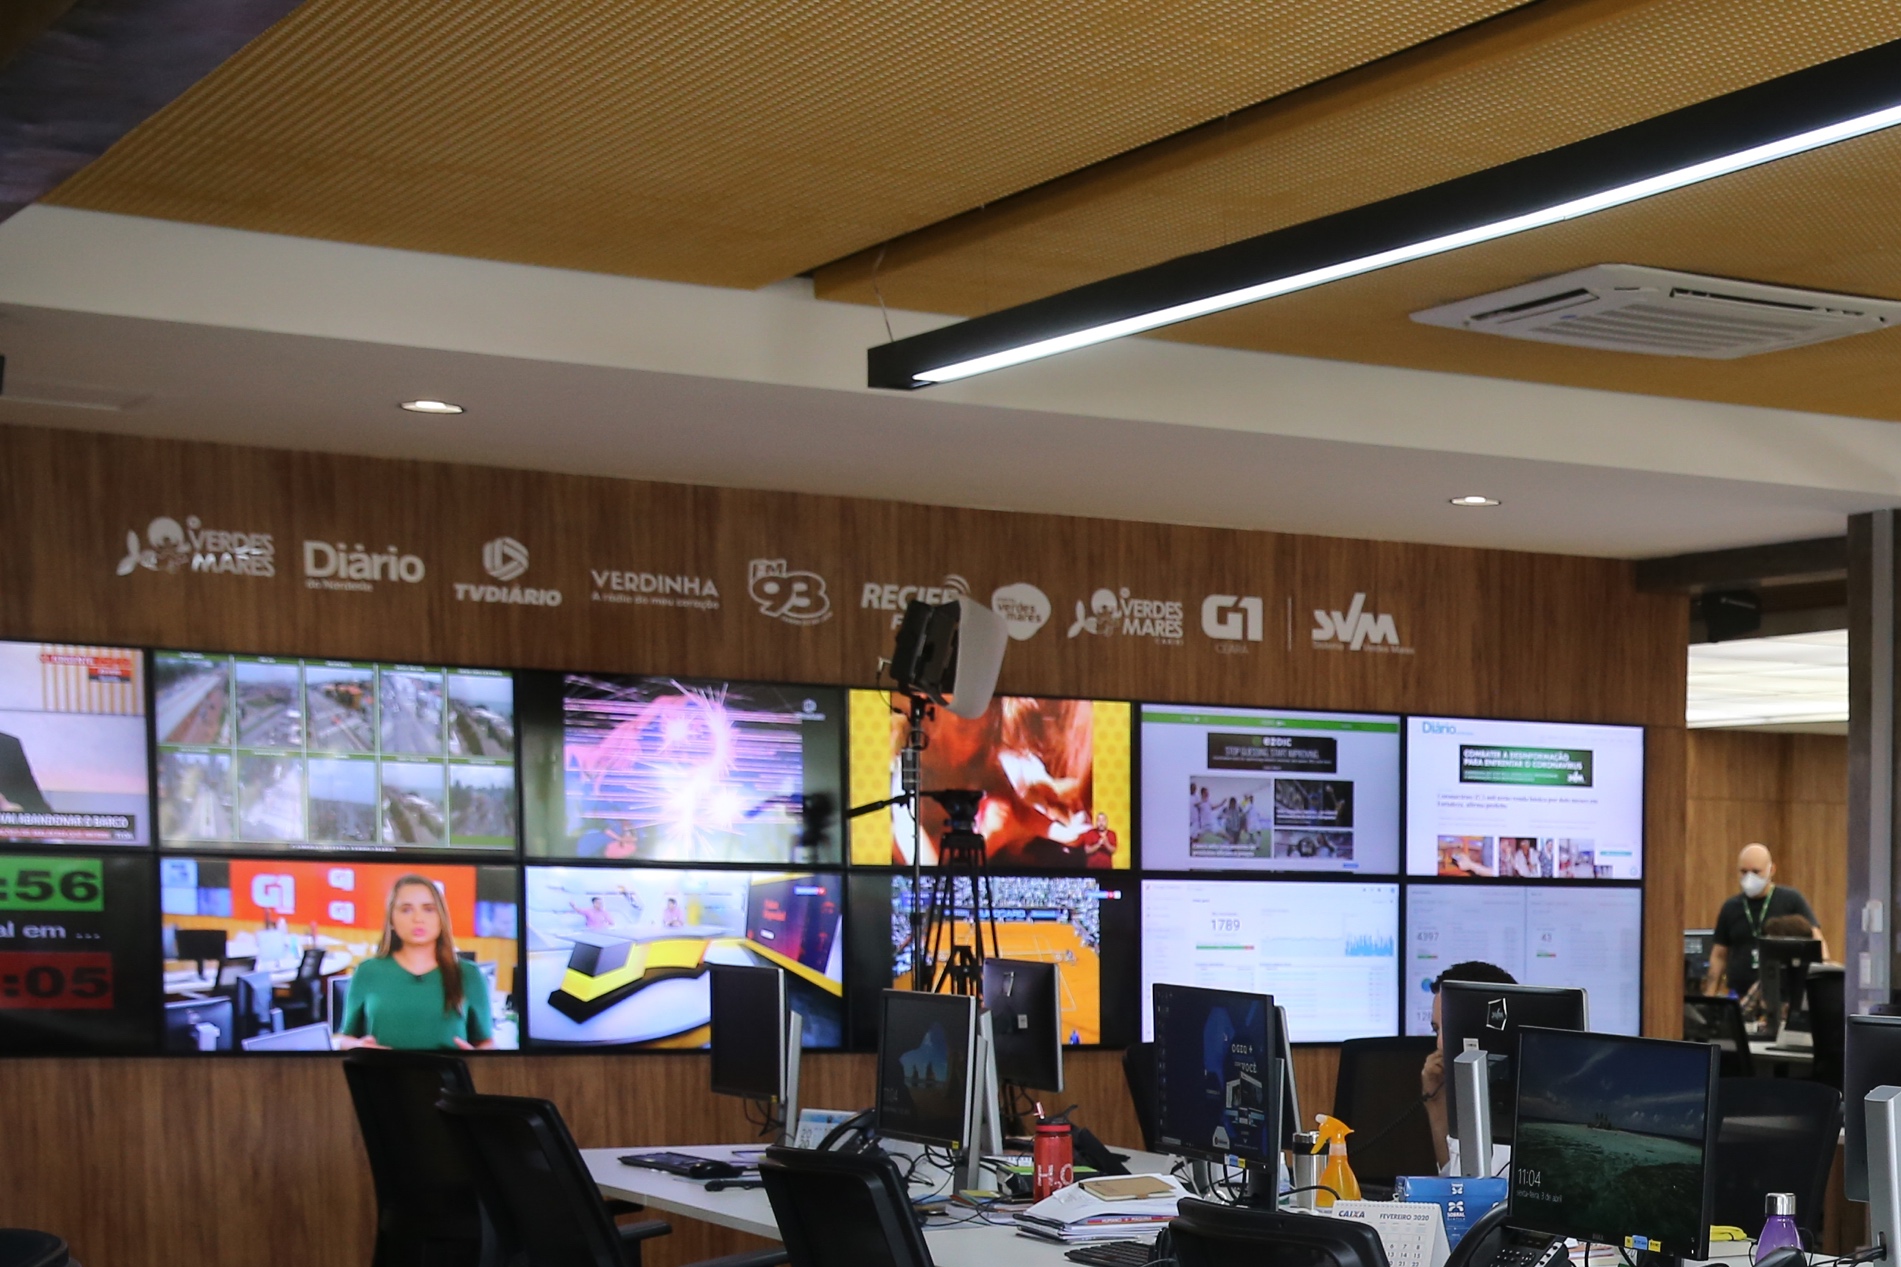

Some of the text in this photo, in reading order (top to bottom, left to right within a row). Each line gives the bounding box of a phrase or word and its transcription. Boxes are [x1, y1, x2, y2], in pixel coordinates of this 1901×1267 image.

[188, 528, 275, 554] VERDES
[191, 551, 275, 577] MARES
[303, 540, 425, 583] Diário
[590, 570, 719, 597] VERDINHA
[1121, 599, 1183, 620] VERDES
[1201, 594, 1263, 641] G1
[1122, 618, 1184, 638] MARES
[1311, 592, 1400, 651] SVM
[22, 924, 66, 938] em
[1211, 919, 1241, 931] 1789
[1518, 1168, 1541, 1187] 11:04
[1338, 1210, 1365, 1218] CAIXA
